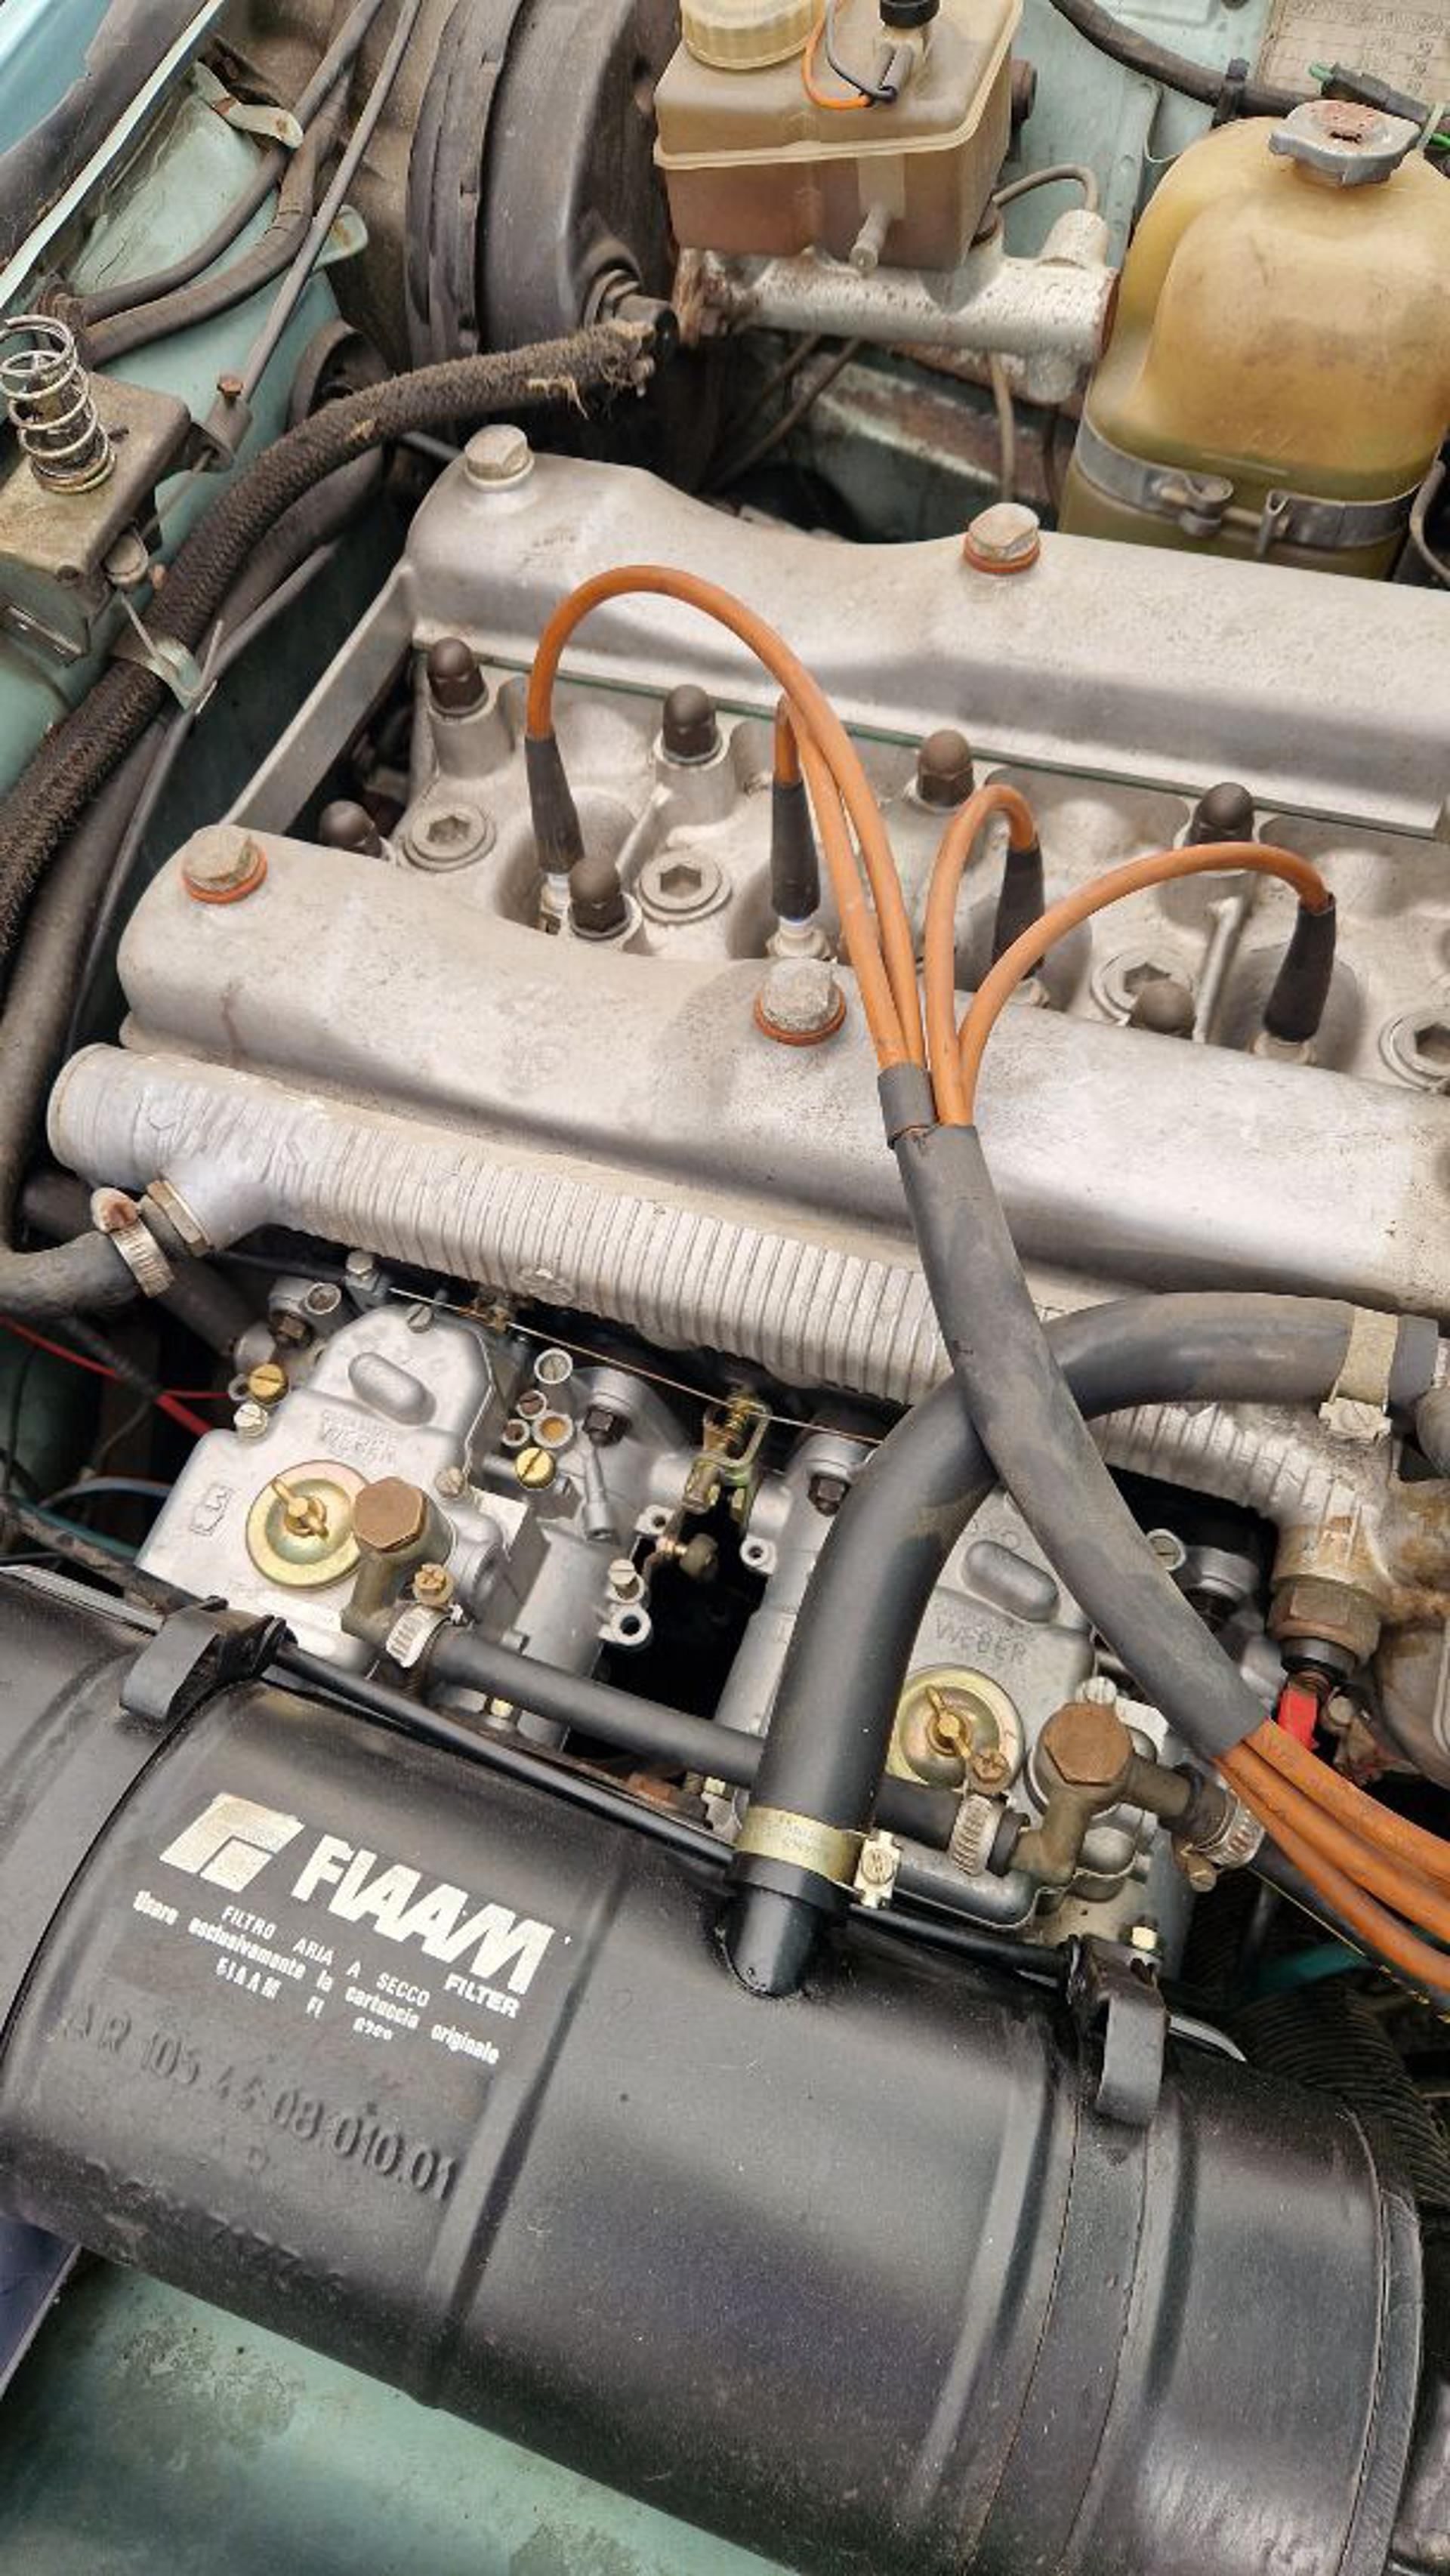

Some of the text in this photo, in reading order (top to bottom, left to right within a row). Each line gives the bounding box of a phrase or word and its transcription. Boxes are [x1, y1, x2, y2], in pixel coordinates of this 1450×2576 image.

[936, 1615, 1028, 1664] WEBER
[221, 1905, 430, 2007] FILTRO ARIA A SECCO
[291, 1834, 555, 1994] FIAAM
[188, 1917, 306, 1980] esclusivamente
[316, 1969, 334, 1993] la
[344, 1986, 420, 2029] cartuccia
[430, 2024, 499, 2065] originale
[443, 1973, 520, 2019] FILTER
